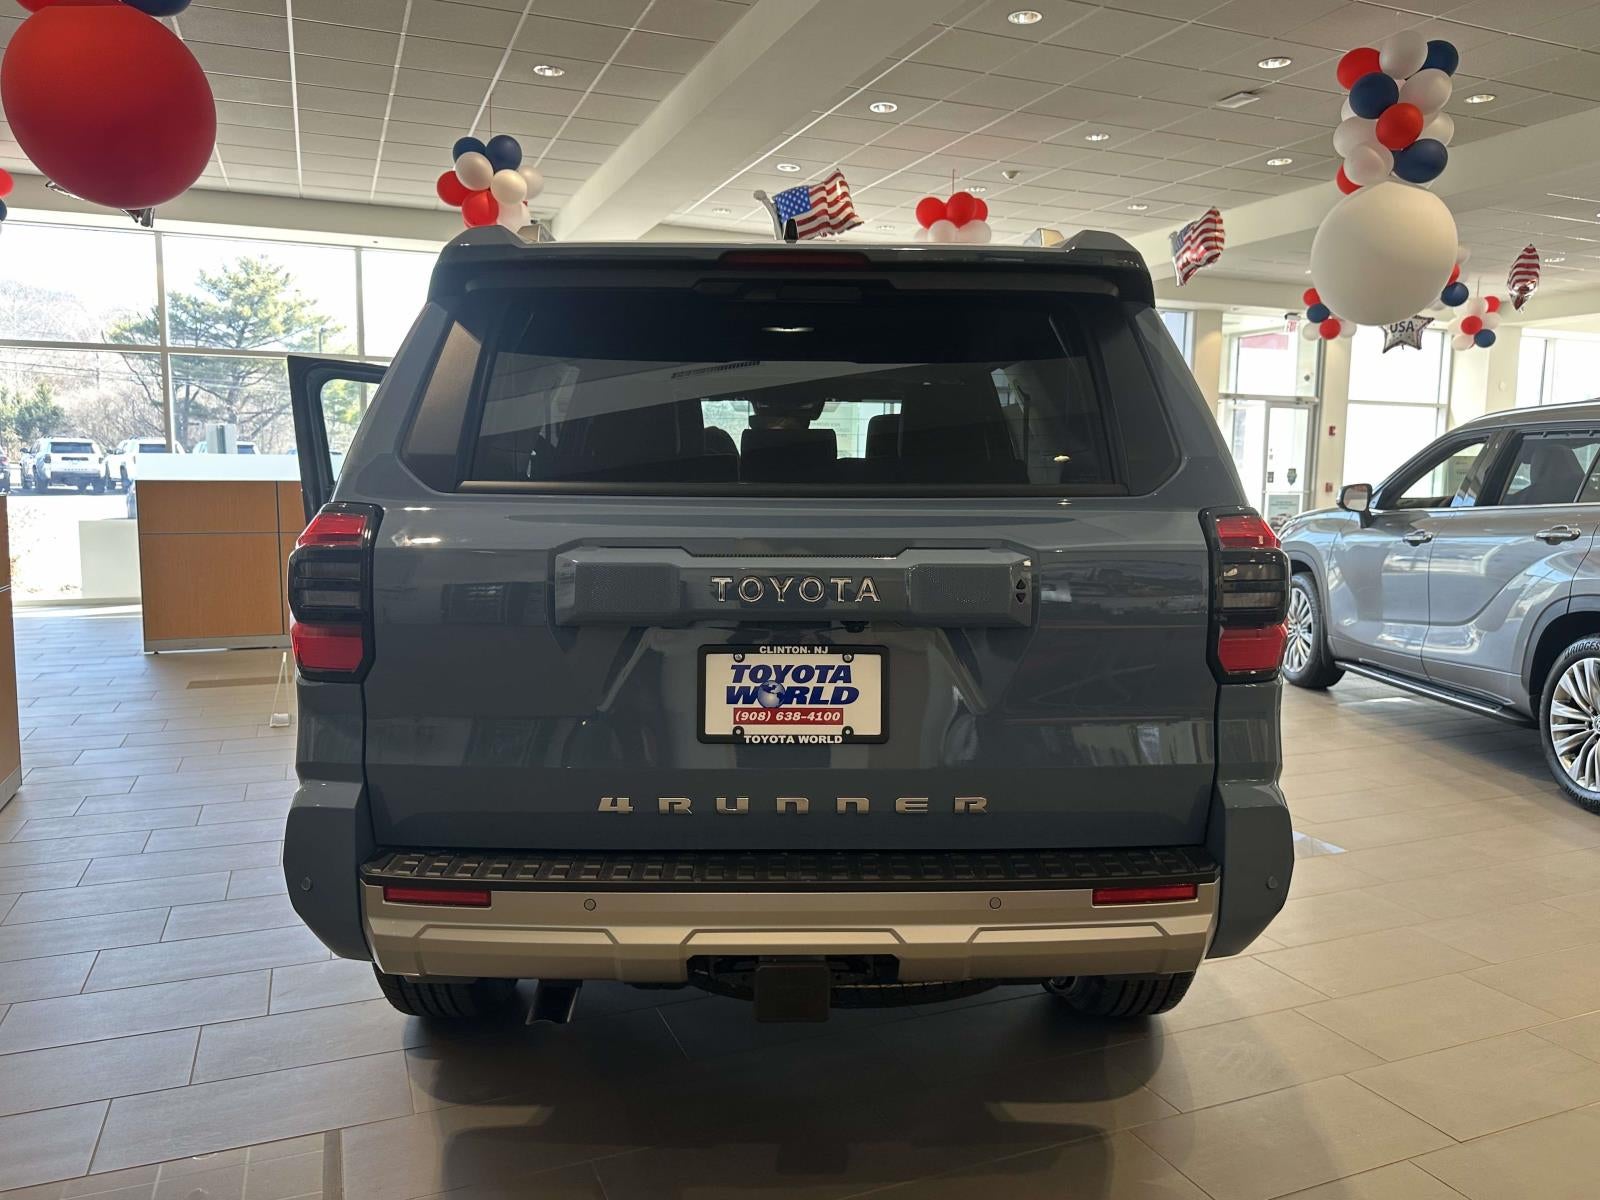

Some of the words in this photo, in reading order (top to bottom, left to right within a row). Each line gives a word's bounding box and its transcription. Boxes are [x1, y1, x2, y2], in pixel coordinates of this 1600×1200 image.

[1390, 320, 1415, 333] USA
[711, 576, 881, 602] TOYOTA
[814, 646, 829, 654] NJ
[730, 664, 852, 684] TOYOTA
[726, 685, 860, 708] WORLD
[735, 710, 771, 722] (908)
[775, 711, 841, 721] 638-4100
[743, 735, 795, 744] TOYOTA
[798, 735, 843, 744] WORLD
